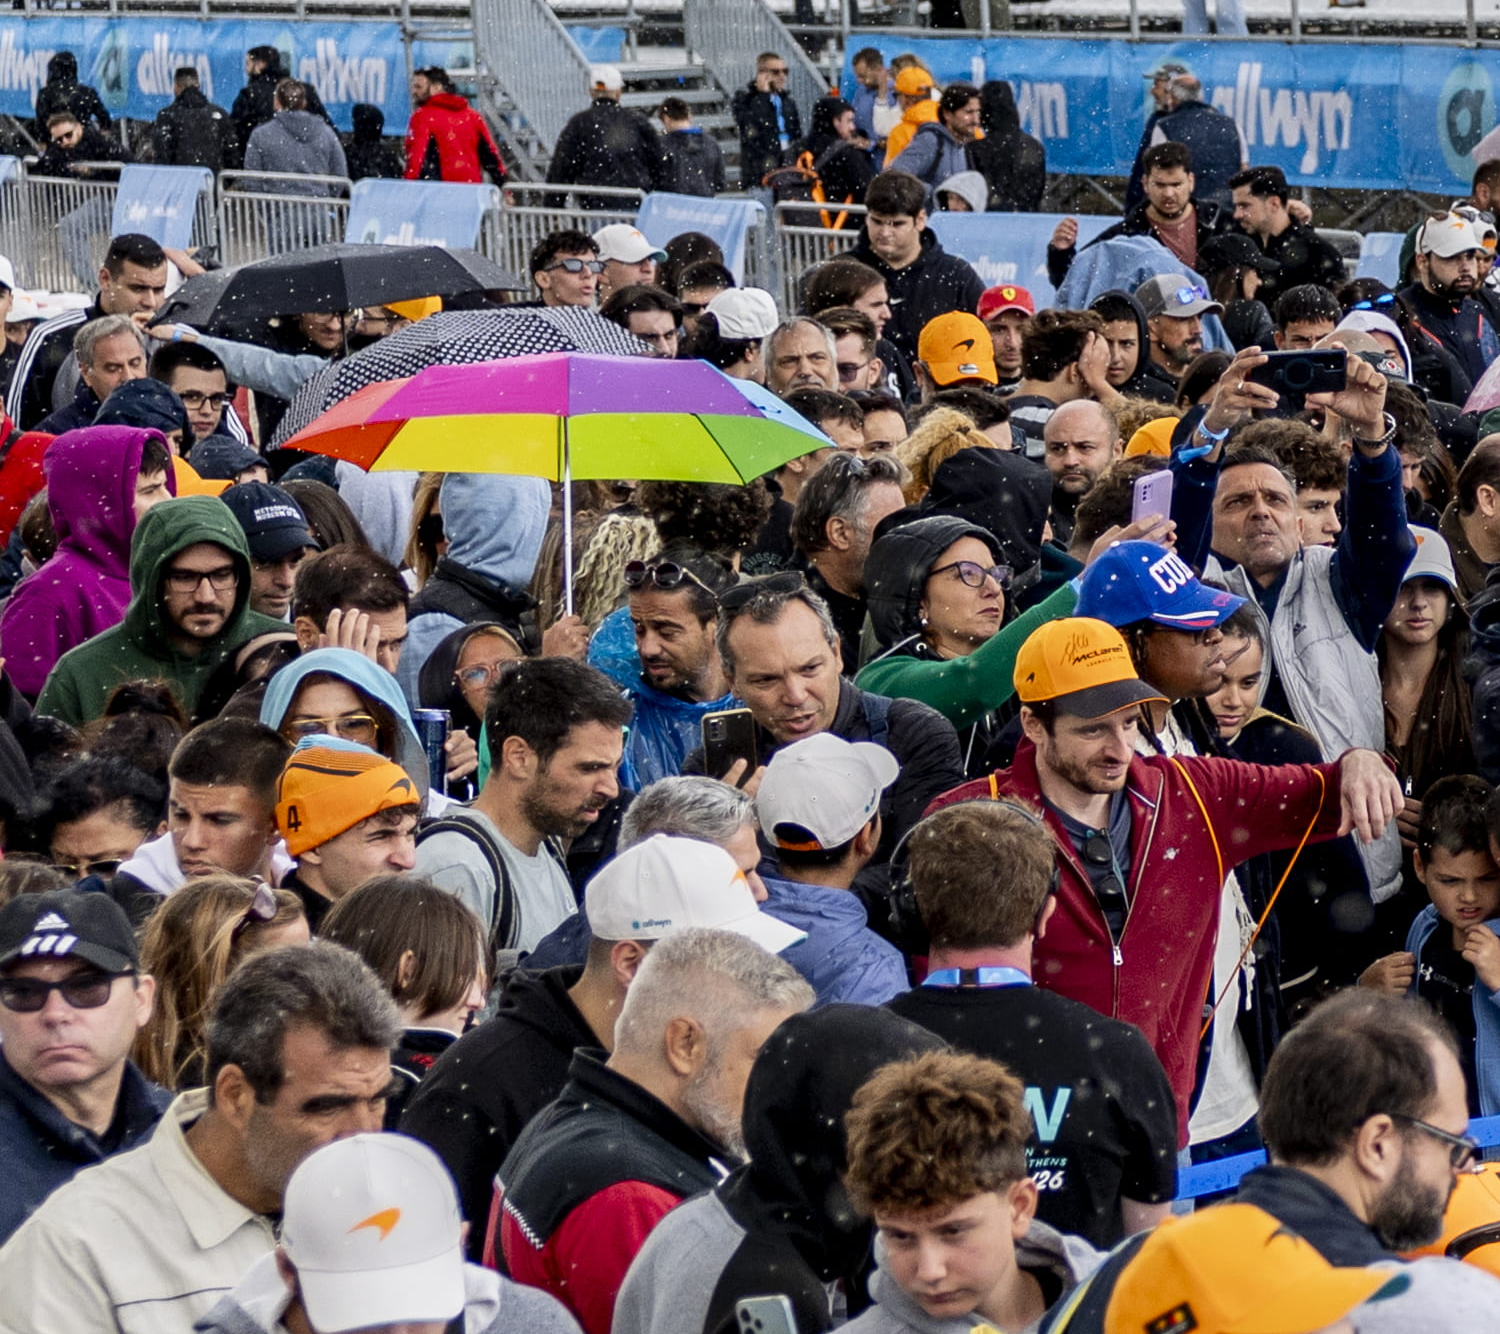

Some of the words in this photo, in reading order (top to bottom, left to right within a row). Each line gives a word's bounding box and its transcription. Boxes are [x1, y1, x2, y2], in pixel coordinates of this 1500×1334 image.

[1211, 63, 1351, 174] allwyn
[287, 804, 303, 833] 4
[1029, 1157, 1068, 1167] THENS
